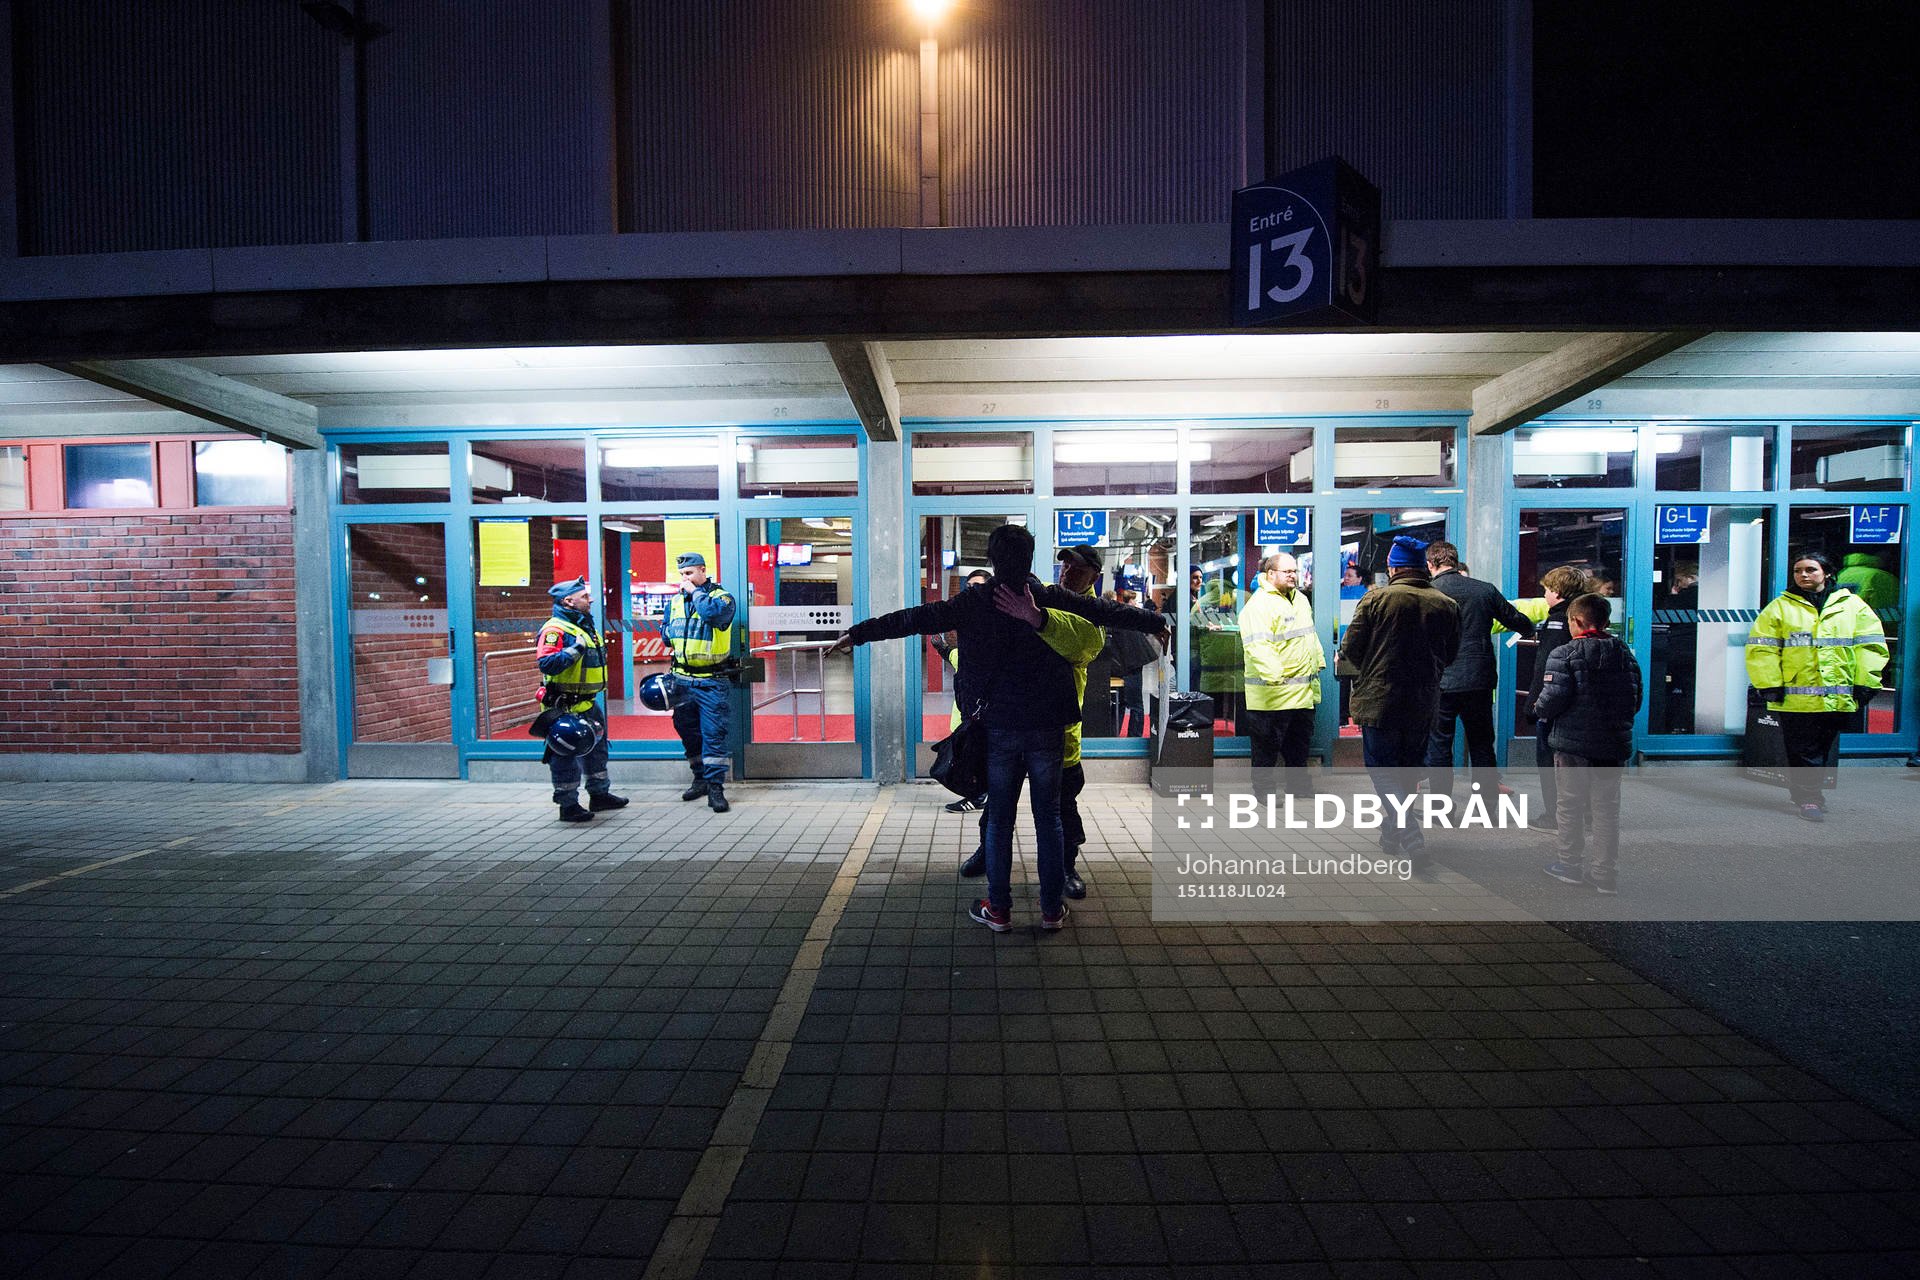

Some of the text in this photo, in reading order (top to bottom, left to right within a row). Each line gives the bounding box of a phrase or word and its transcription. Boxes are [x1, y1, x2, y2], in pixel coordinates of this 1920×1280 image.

[1250, 206, 1293, 232] Entré
[1248, 227, 1315, 310] 13
[1339, 222, 1367, 305] 13
[982, 402, 996, 414] 27
[1587, 399, 1602, 409] 29
[1264, 508, 1299, 525] M-S
[1666, 507, 1698, 523] G-L
[1859, 507, 1890, 523] A-F
